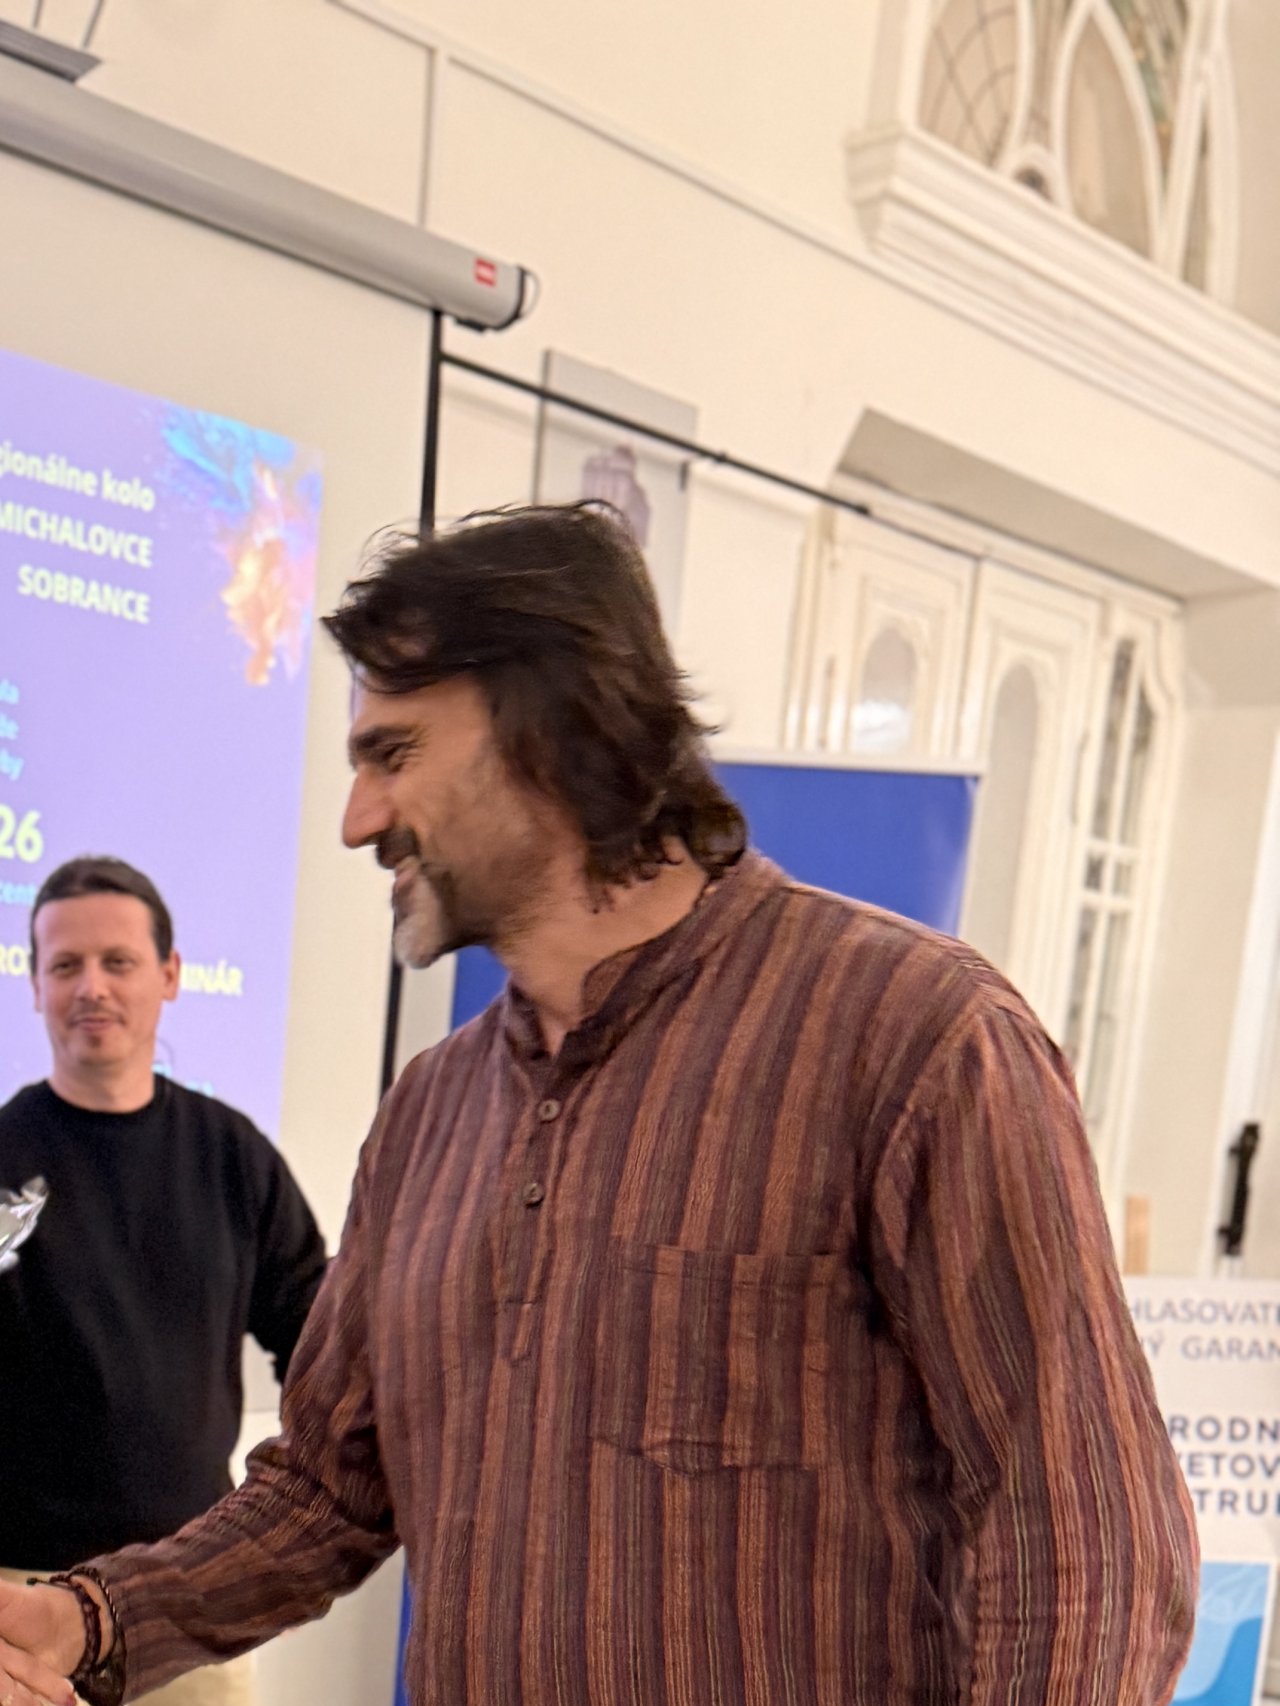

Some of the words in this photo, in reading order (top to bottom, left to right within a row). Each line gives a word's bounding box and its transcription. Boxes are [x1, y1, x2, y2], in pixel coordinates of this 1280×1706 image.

[101, 468, 155, 512] kolo
[17, 563, 150, 624] SOBRANCE
[1177, 1451, 1280, 1480] ETOV
[1192, 1487, 1280, 1517] TRU
